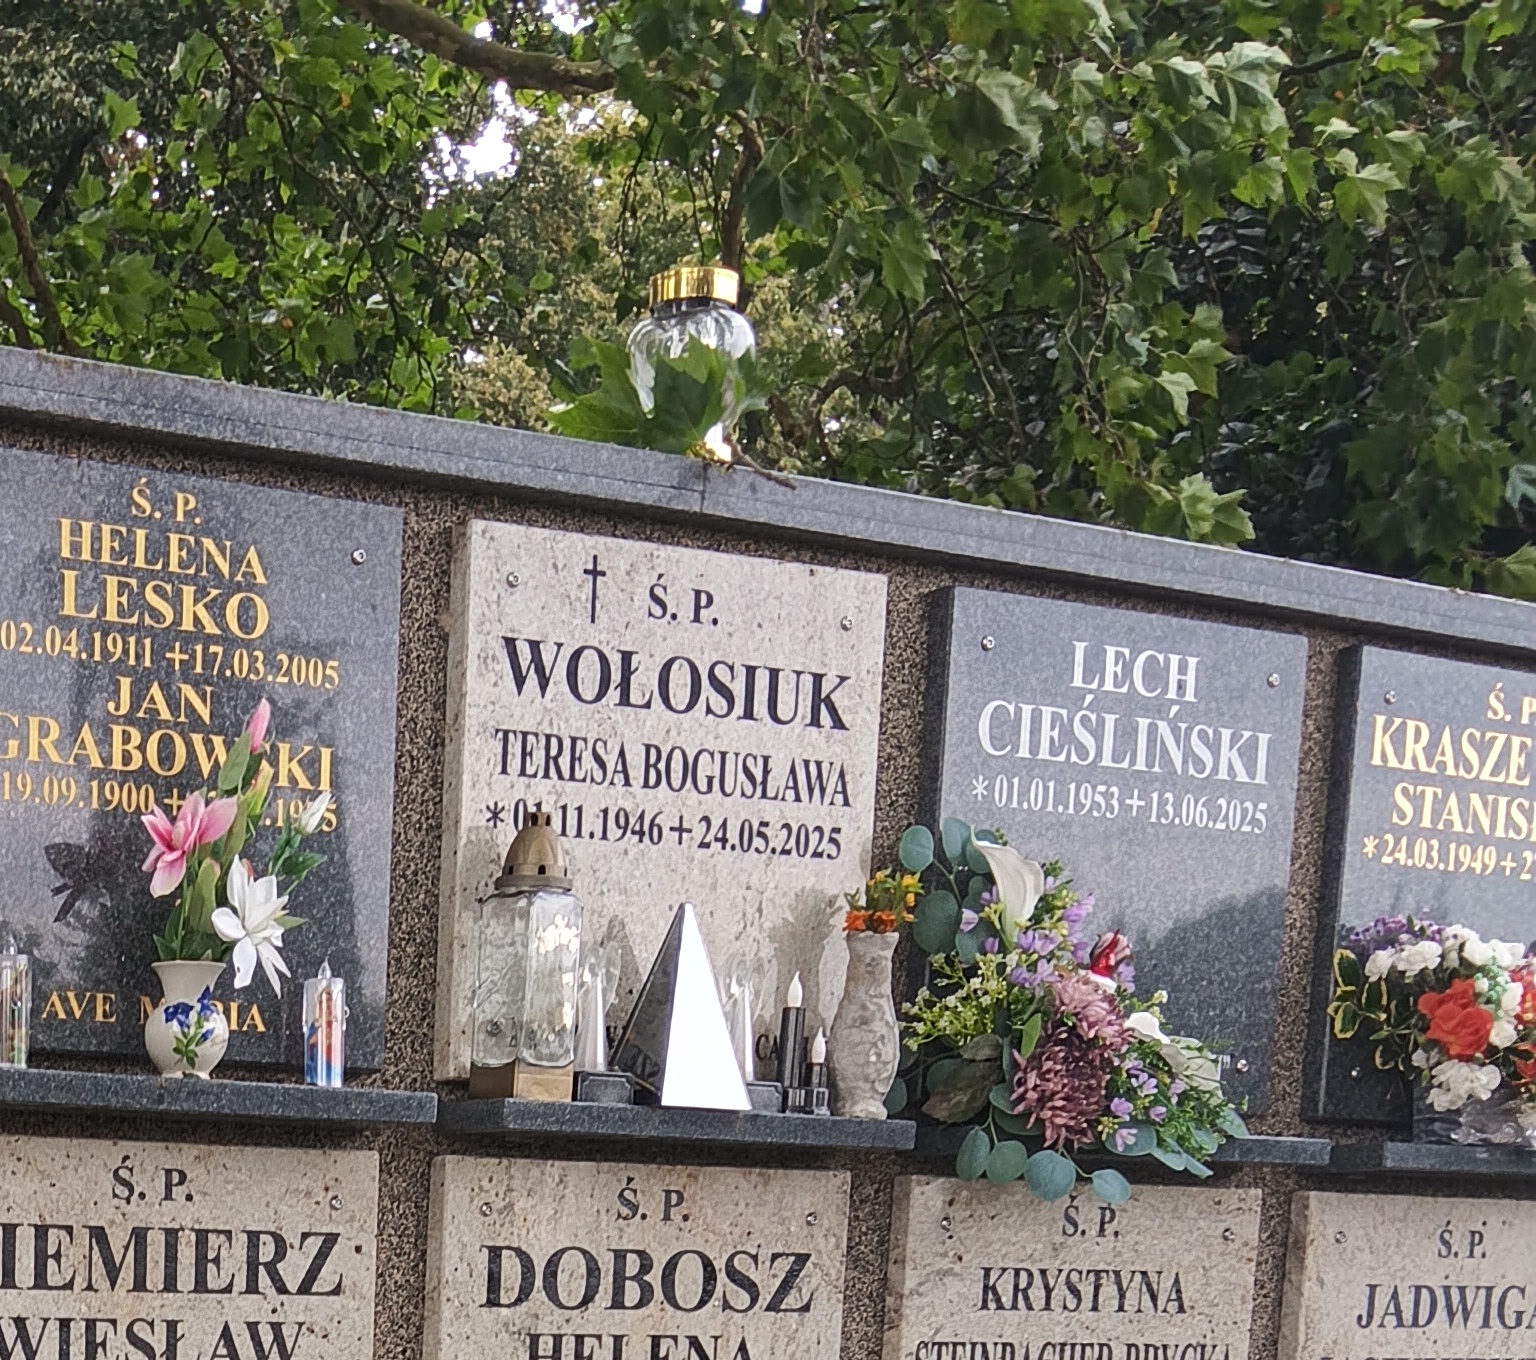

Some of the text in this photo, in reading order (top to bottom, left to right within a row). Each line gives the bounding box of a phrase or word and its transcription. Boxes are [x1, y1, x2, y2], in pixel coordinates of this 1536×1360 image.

[132, 478, 201, 524] Ś. P.
[61, 518, 268, 584] HELENA
[59, 570, 269, 639] LESKO
[648, 574, 719, 626] Ś. P.
[501, 636, 851, 731] WOŁOSIUK
[1069, 641, 1200, 702] LECH
[107, 676, 213, 725] JAN
[1487, 682, 1511, 720] Ś.
[978, 694, 1272, 785] CIEŚLIŃSKI
[495, 728, 851, 807] TERESA BOGUSŁAWA
[1392, 782, 1536, 843] STANIS
[41, 990, 116, 1023] AVE
[112, 1155, 194, 1202] Ś. P.
[617, 1176, 689, 1221] Ś. P.
[1063, 1194, 1119, 1238] Ś. P.
[1437, 1221, 1487, 1259] Ś. P.
[480, 1244, 815, 1314] DOBOSZ
[978, 1267, 1186, 1314] KRYSTYNA
